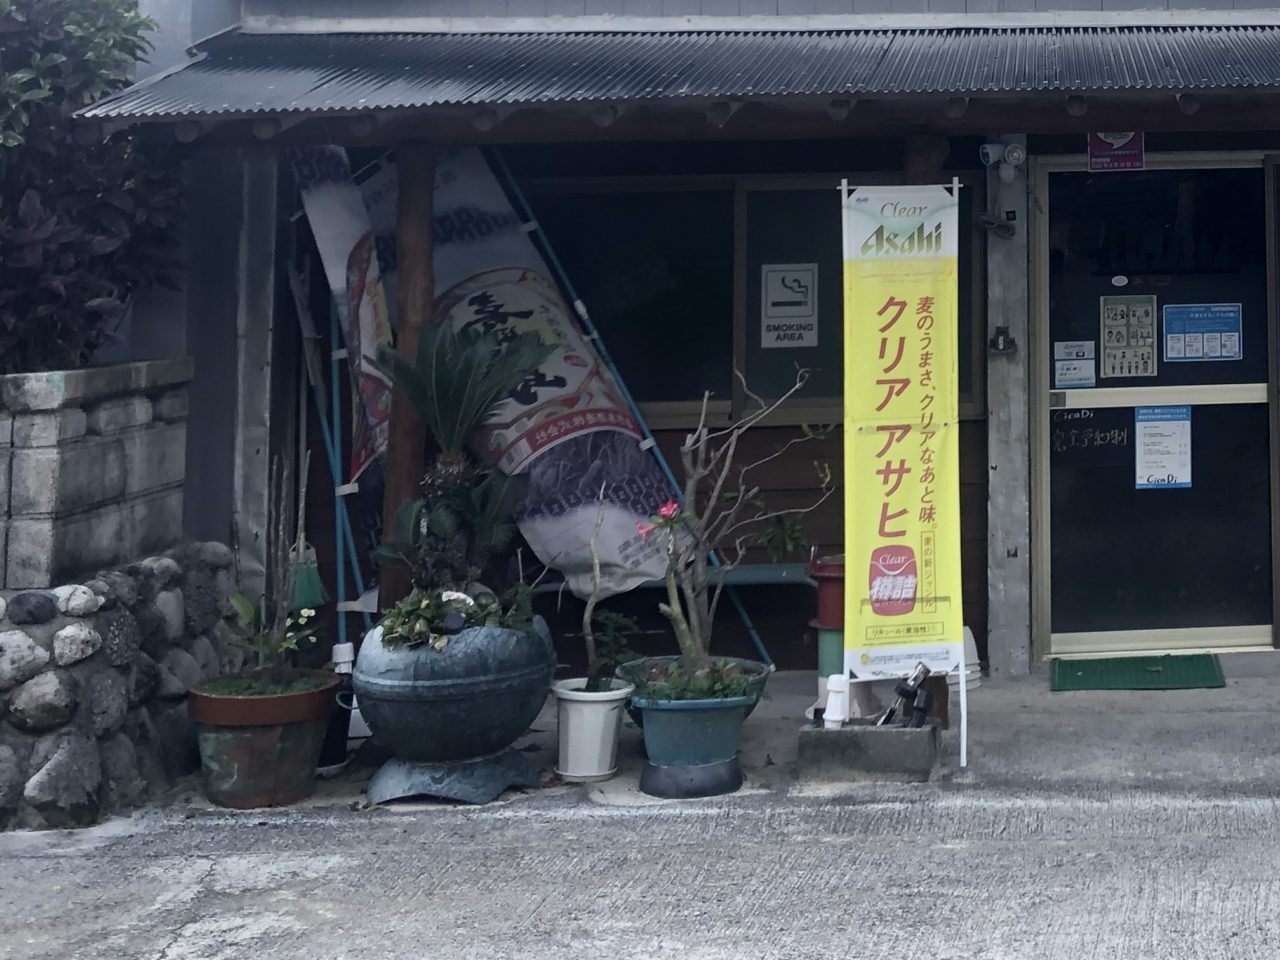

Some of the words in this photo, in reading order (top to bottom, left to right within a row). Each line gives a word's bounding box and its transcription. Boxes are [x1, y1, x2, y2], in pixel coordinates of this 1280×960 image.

[880, 201, 928, 219] Clear
[860, 221, 943, 256] Asahi
[766, 323, 814, 333] SMOKING
[775, 333, 804, 341] AREA
[875, 296, 912, 538] クリアアサヒ
[915, 296, 937, 529] 麦のうまさ、クリアなあと味。
[879, 554, 907, 565] Clear
